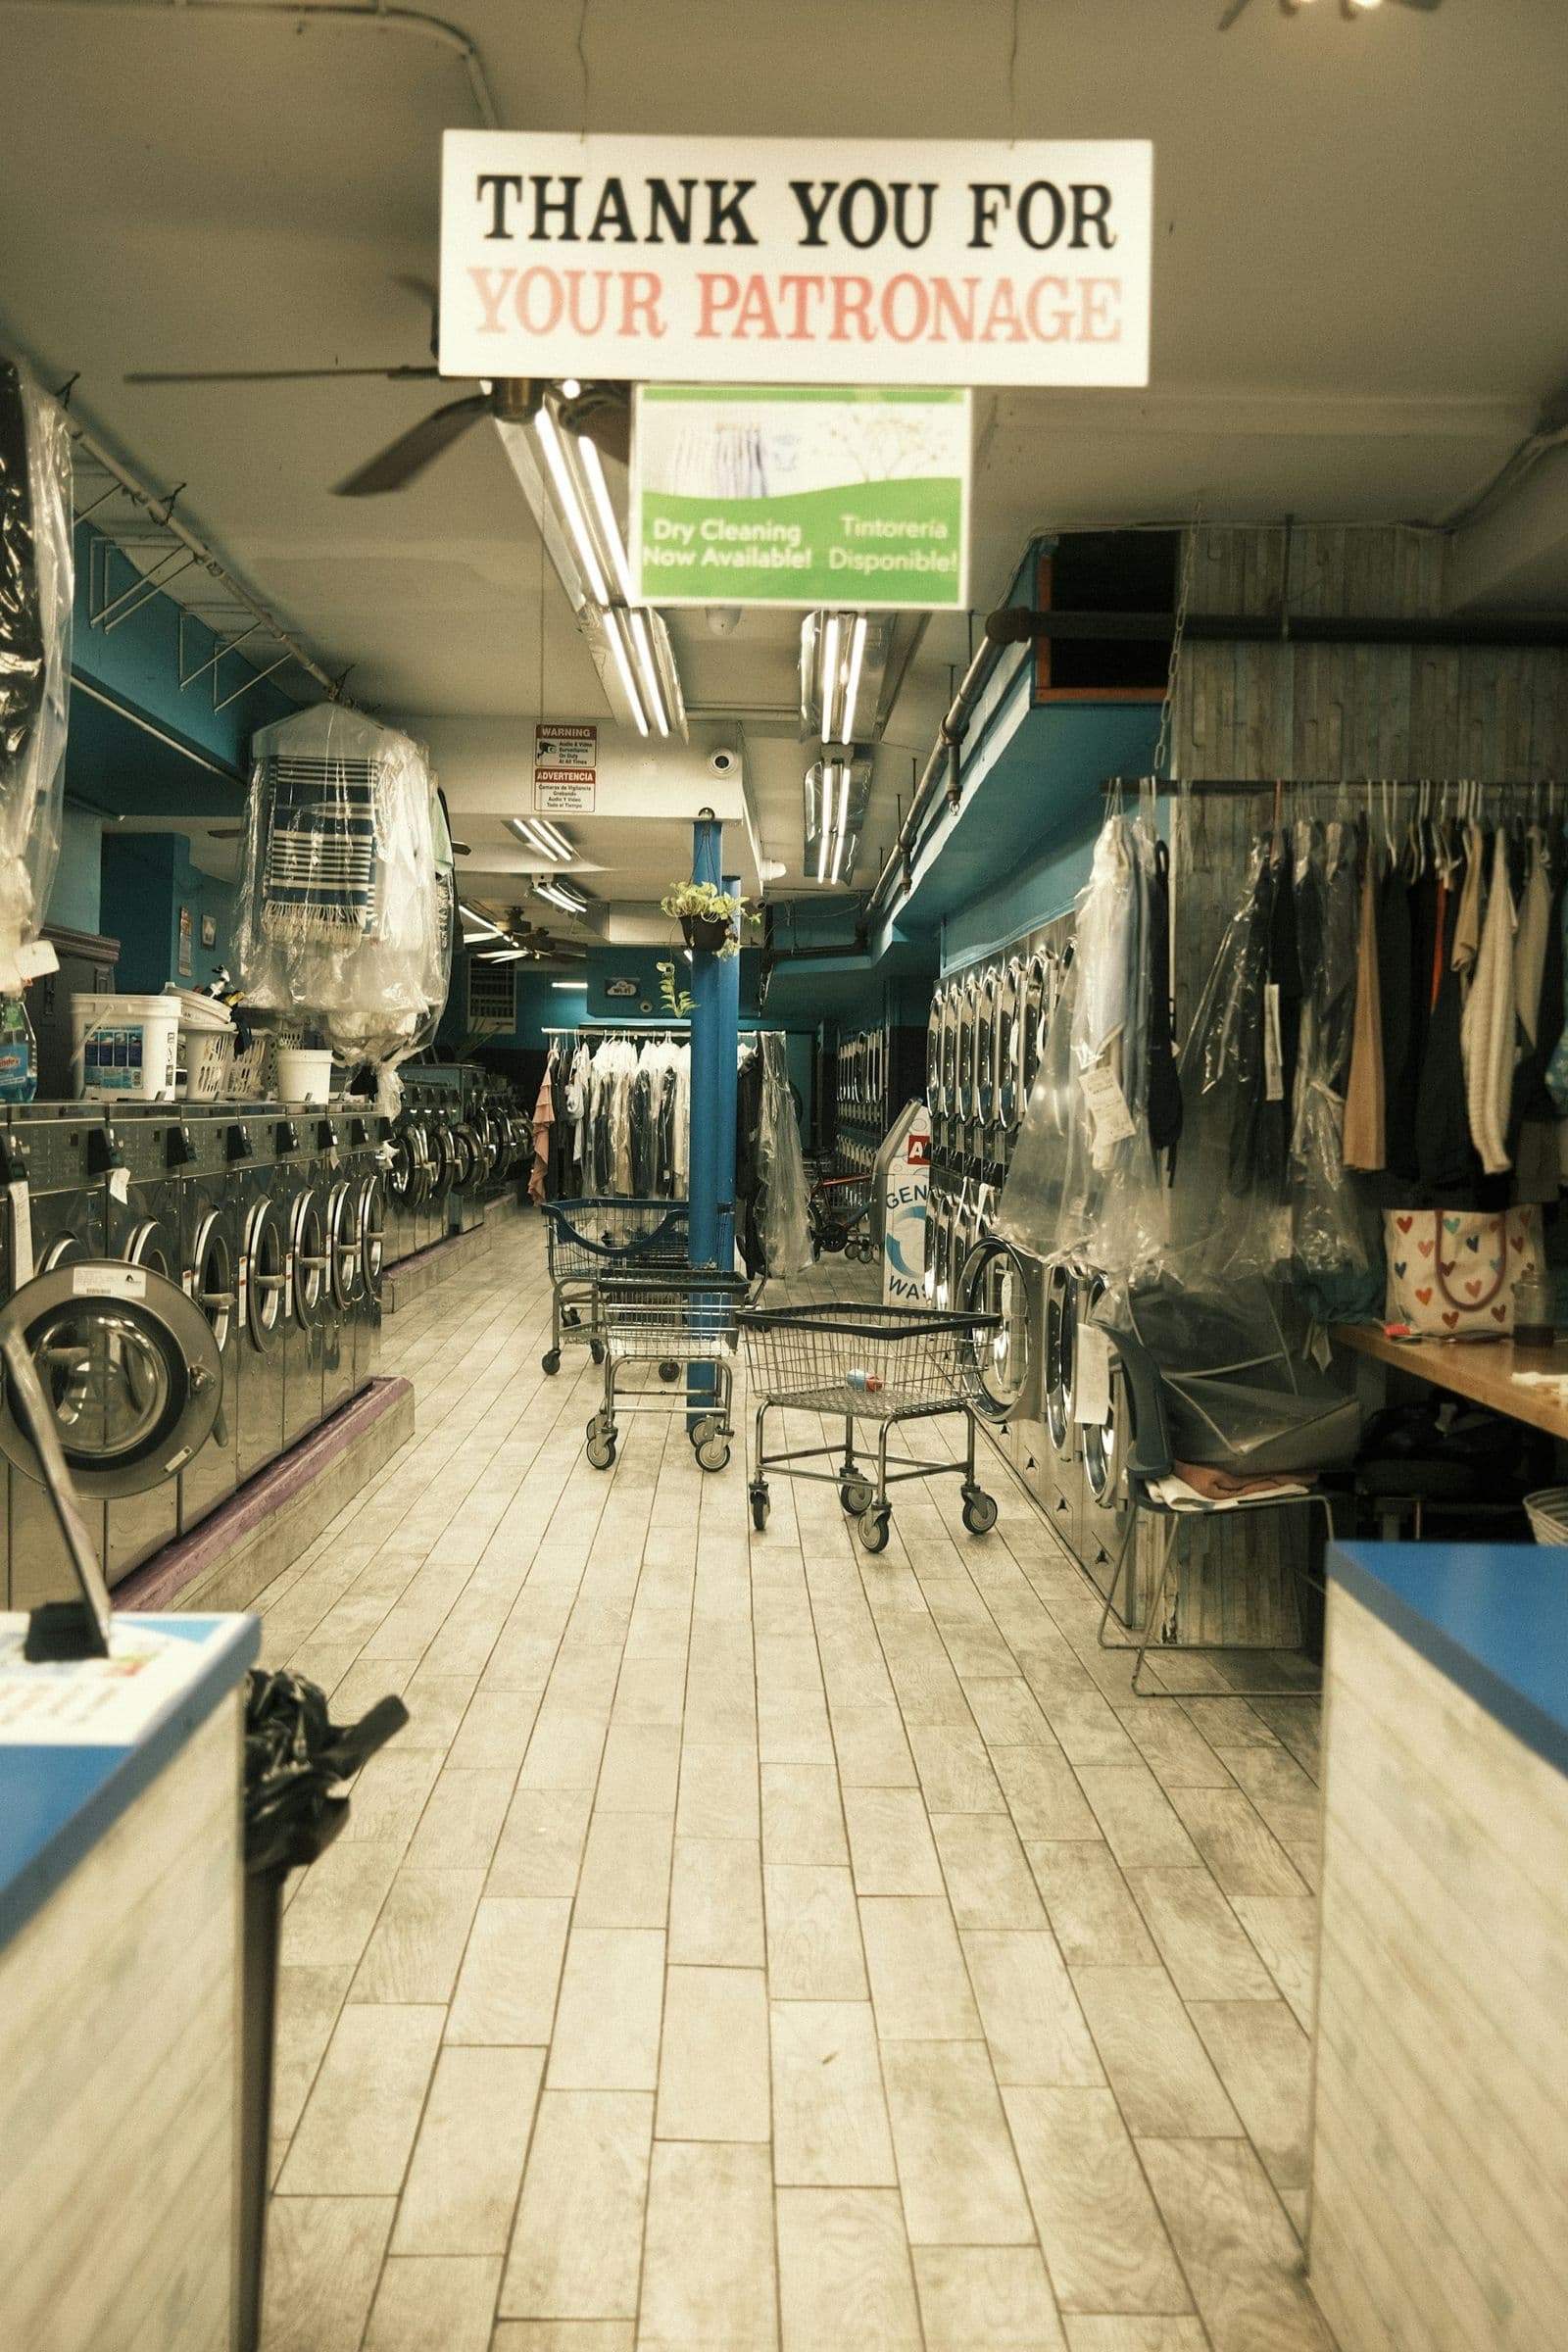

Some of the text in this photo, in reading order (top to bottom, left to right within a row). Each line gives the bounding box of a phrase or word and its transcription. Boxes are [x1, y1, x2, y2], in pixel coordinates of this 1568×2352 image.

[476, 173, 1117, 251] THANK YOU FOR
[466, 266, 1122, 344] YOUR PATRONAGE
[652, 517, 803, 548] Dry Cleaning
[643, 547, 812, 569] Now Available!
[829, 548, 957, 575] Disponible!
[542, 727, 590, 737] WARNING
[537, 771, 594, 781] ADVERTENCIA
[908, 1141, 927, 1158] A
